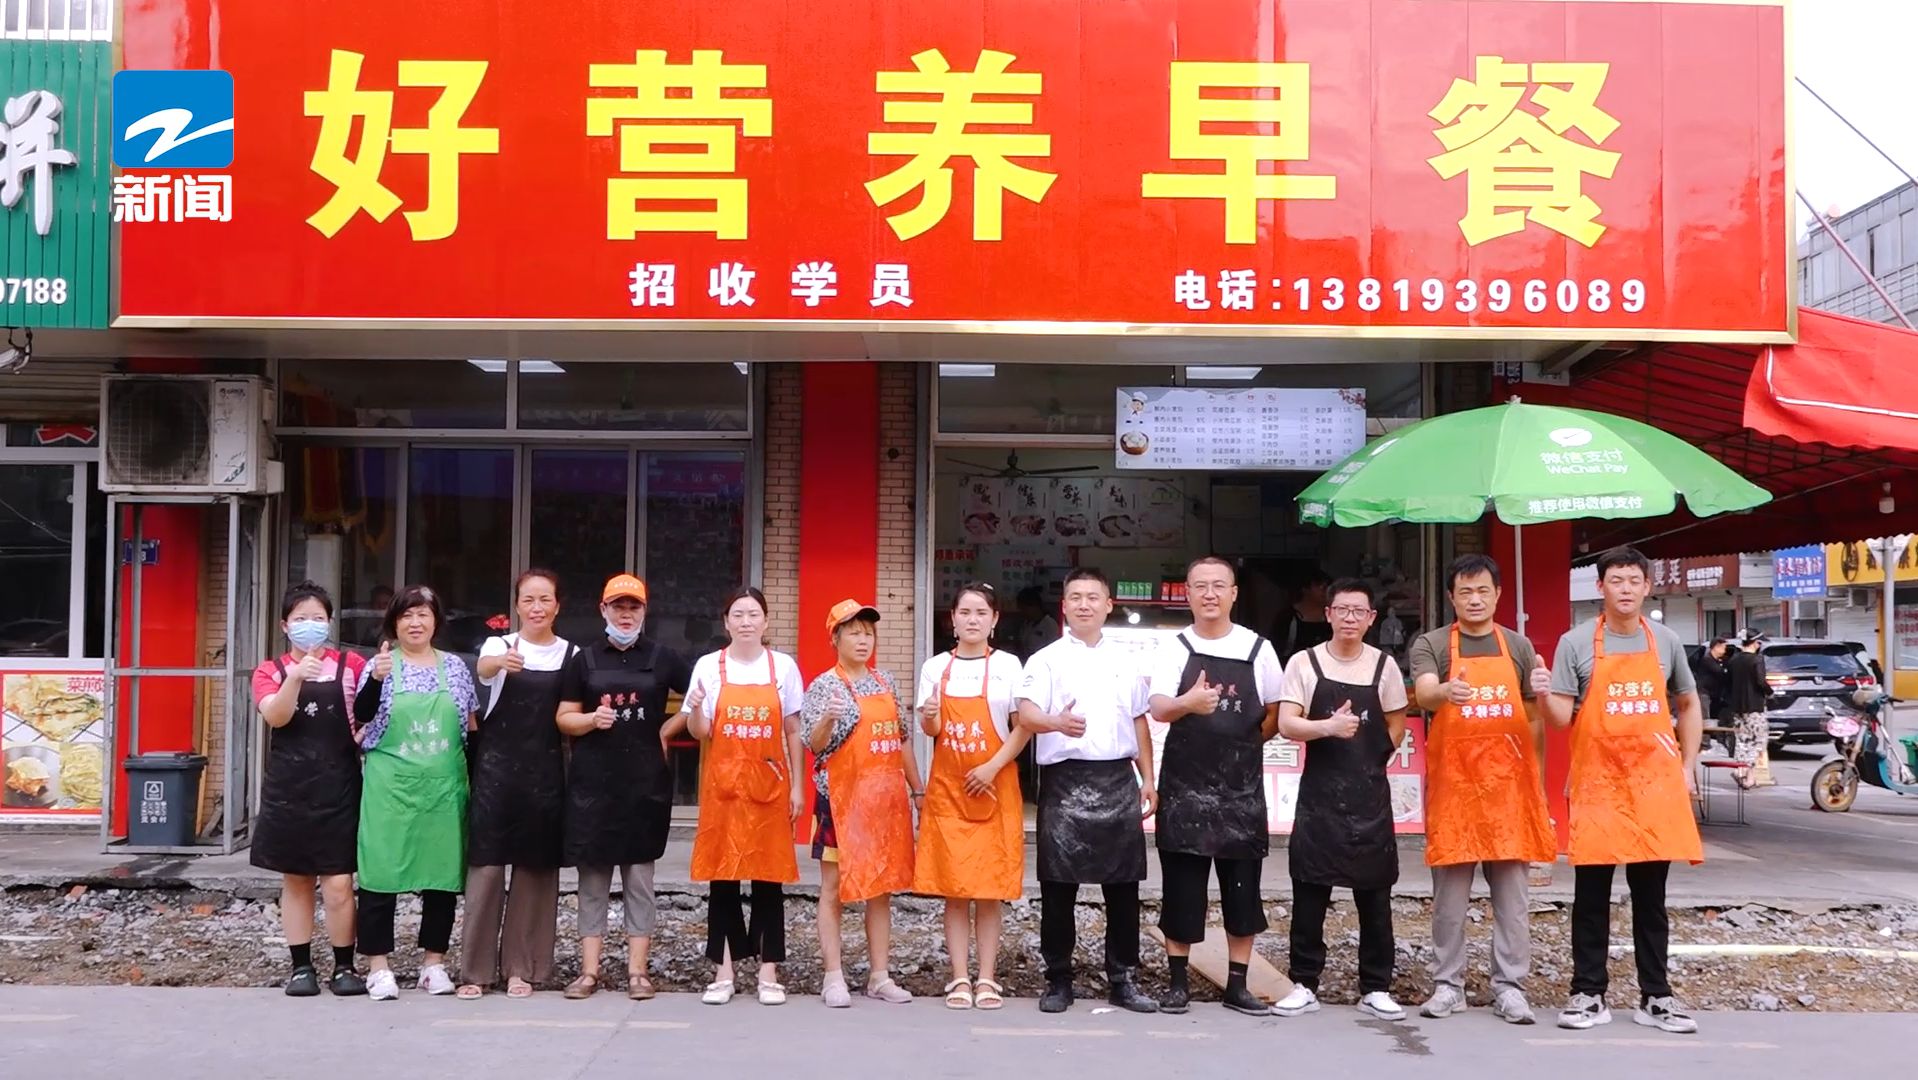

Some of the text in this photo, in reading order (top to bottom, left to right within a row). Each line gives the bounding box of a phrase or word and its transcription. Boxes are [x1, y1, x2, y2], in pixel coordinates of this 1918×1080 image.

[304, 49, 1622, 248] 好营养早餐
[628, 261, 914, 307] 招收学员
[1540, 448, 1624, 465] 微信支付
[1546, 464, 1629, 475] WeChat Pay
[1528, 496, 1643, 514] 推荐使用微信支付
[1607, 680, 1654, 697] 好营养
[726, 705, 771, 721] 好营养
[1461, 704, 1513, 719] 早餐学员
[1604, 699, 1660, 715] 早餐学员
[722, 723, 772, 739] 早餐学员
